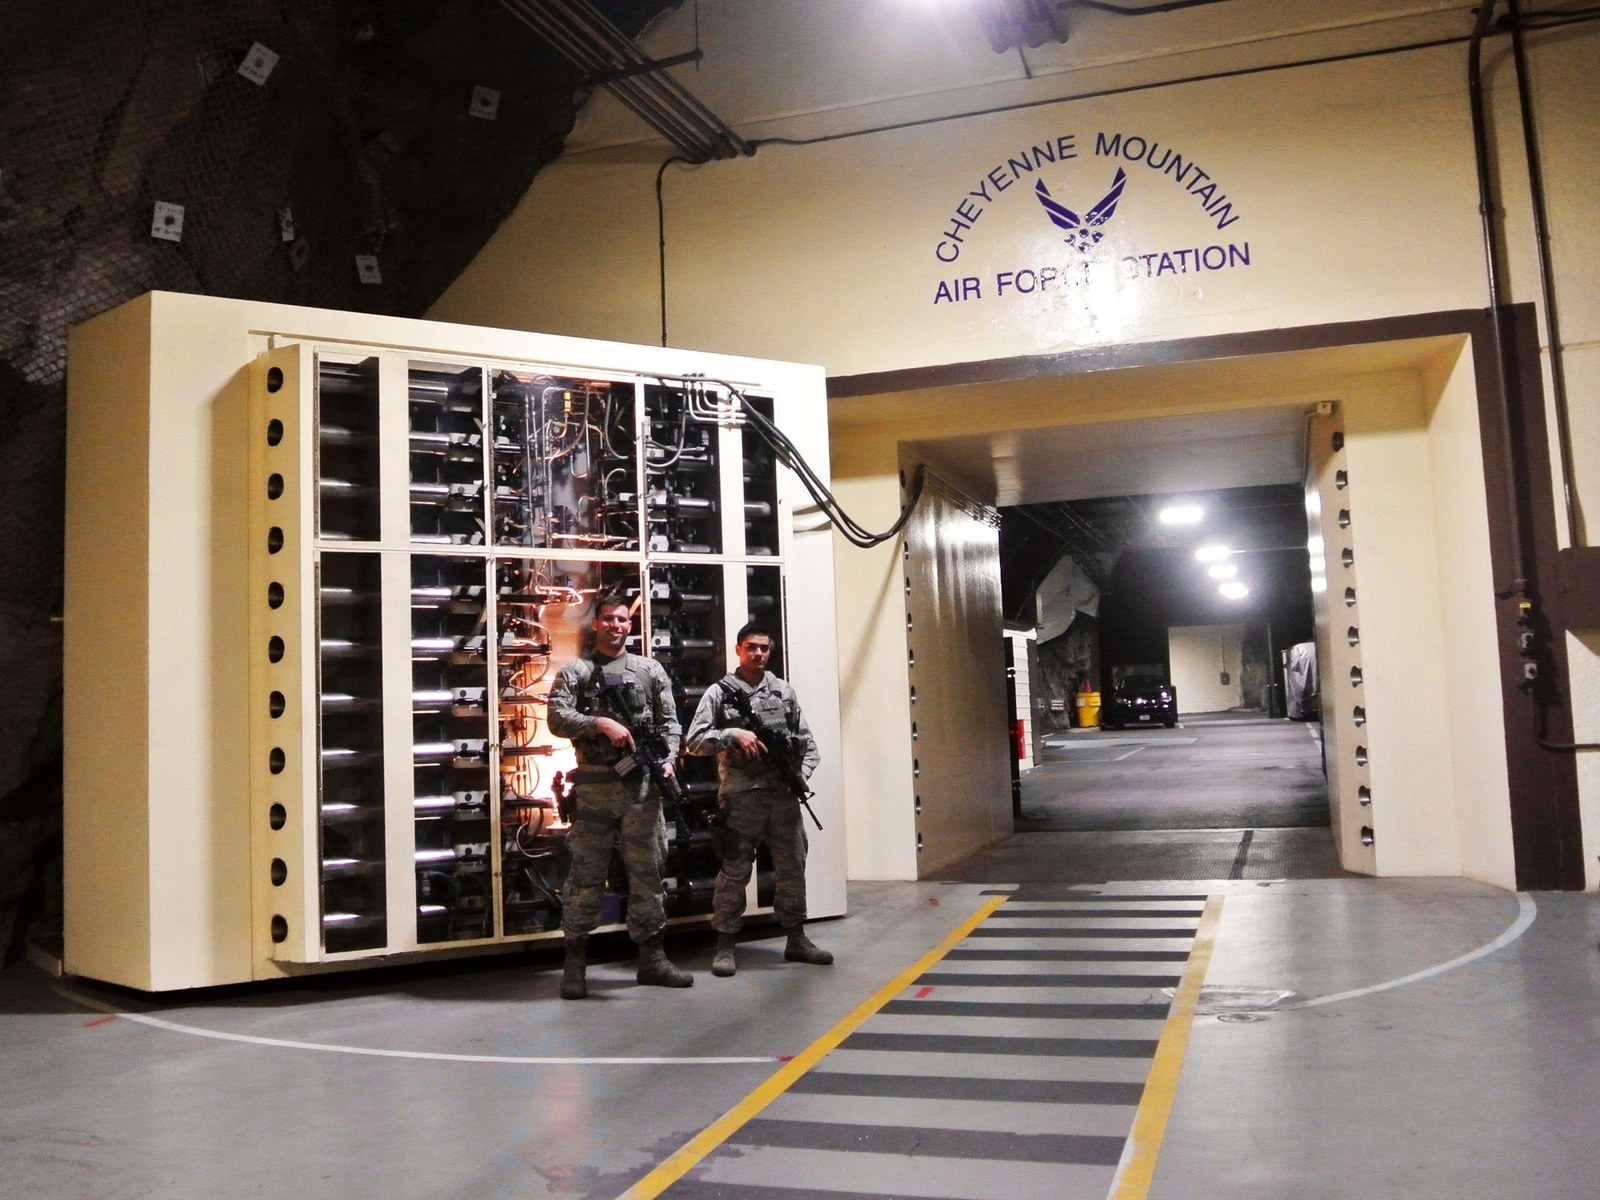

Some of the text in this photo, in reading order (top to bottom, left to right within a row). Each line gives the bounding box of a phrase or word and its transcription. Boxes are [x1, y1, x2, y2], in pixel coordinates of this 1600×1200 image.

[935, 132, 1240, 263] CHEYENNE MOUNTAIN
[933, 277, 982, 305] AIR
